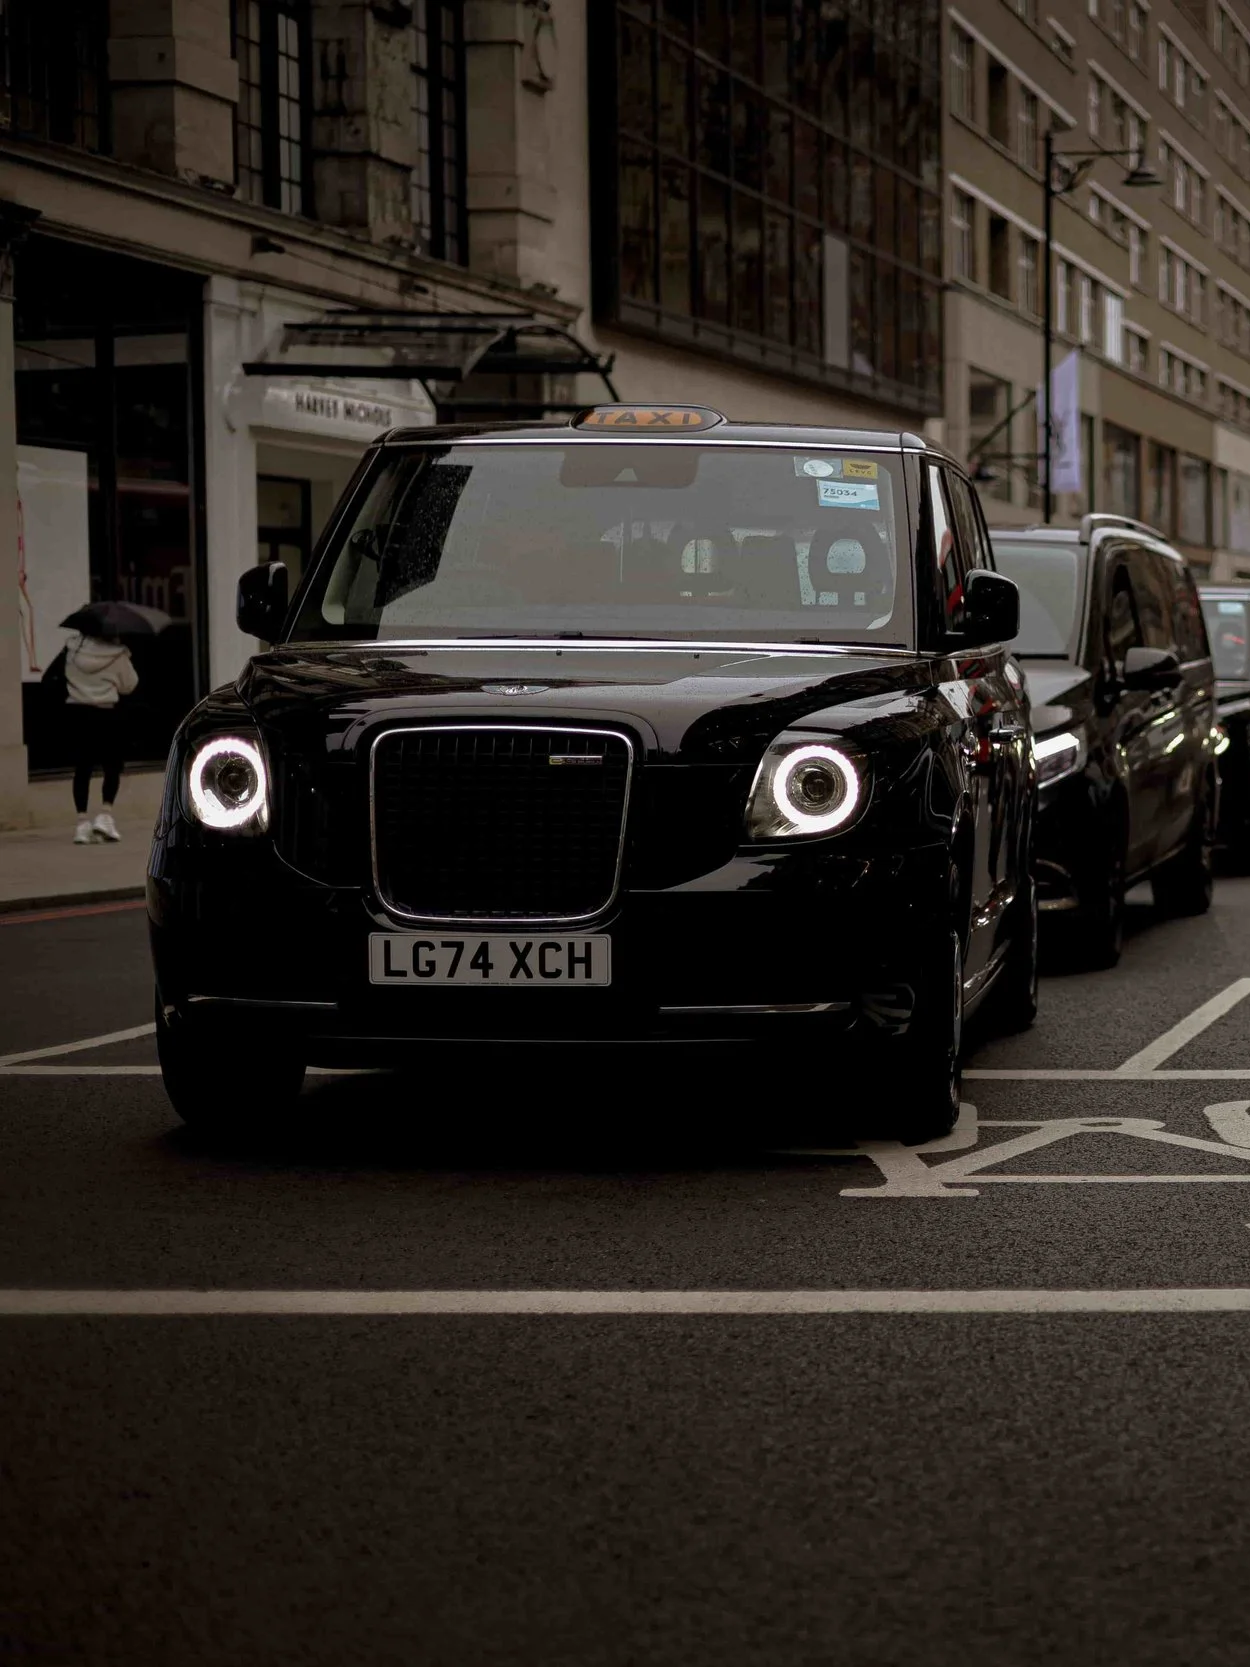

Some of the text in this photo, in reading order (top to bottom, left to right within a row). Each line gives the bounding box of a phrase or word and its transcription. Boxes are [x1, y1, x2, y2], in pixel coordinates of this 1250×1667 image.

[597, 411, 691, 425] TAXI
[823, 488, 857, 497] 75034
[383, 940, 592, 979] LG74 XCH
